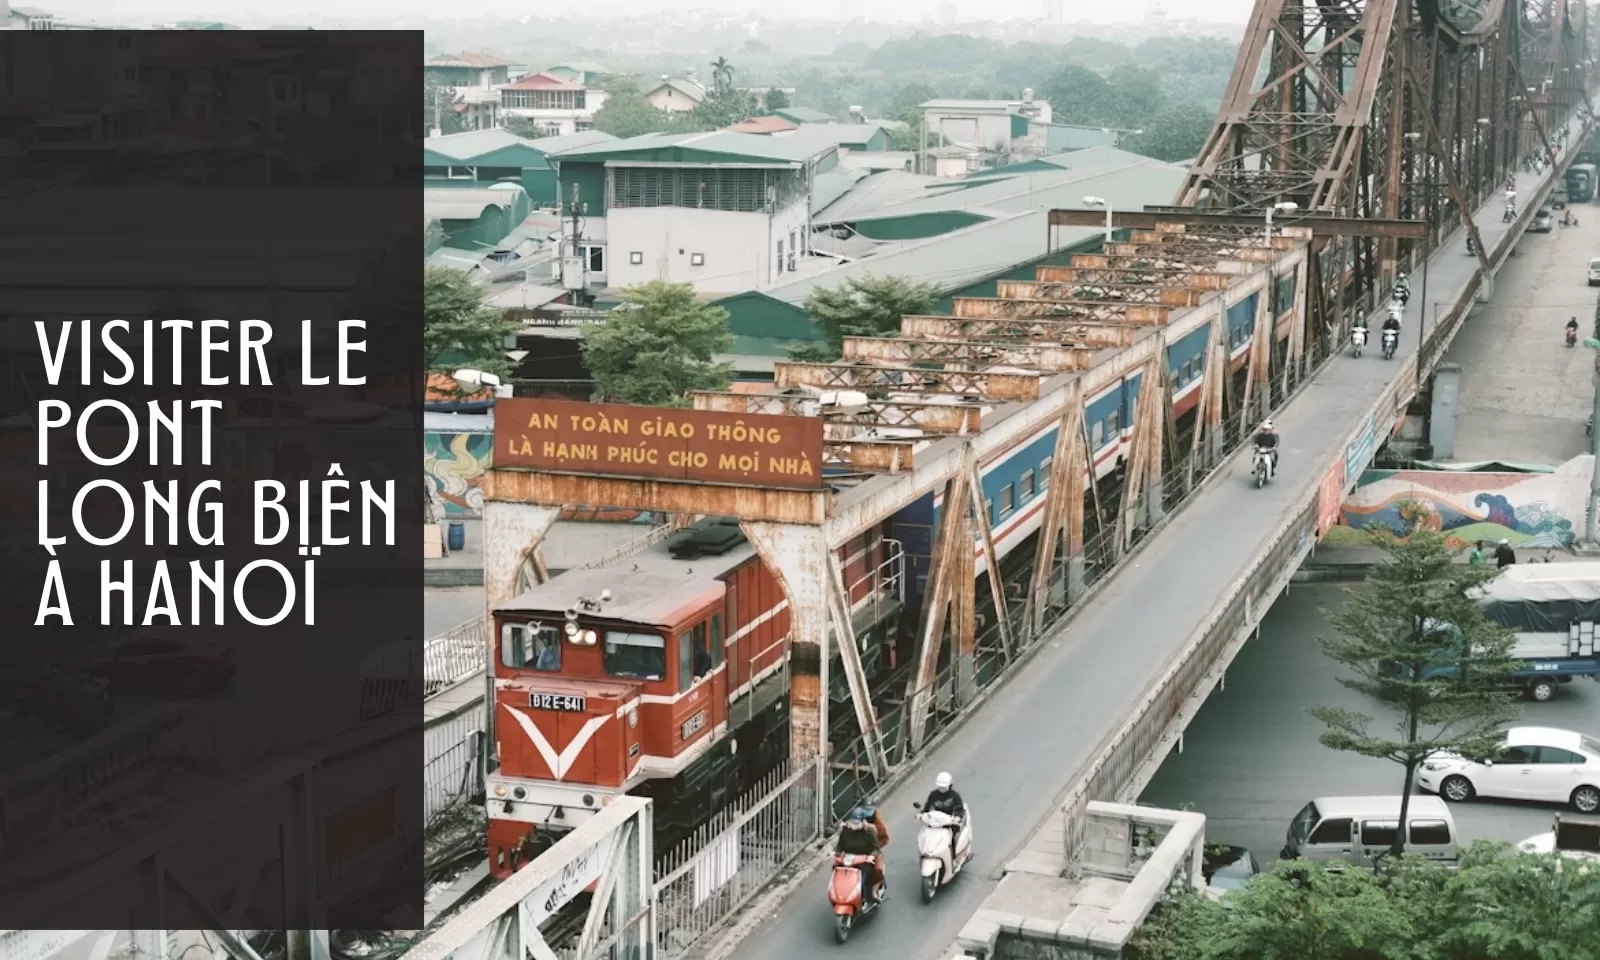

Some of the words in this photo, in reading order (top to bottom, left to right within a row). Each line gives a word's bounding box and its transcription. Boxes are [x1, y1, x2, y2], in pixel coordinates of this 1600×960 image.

[528, 412, 559, 430] AN
[570, 411, 629, 435] TOÀN
[706, 419, 782, 444] THÔNG
[508, 434, 533, 456] LÀ
[543, 441, 598, 461] HẠNH
[607, 441, 659, 465] PHÚC
[668, 450, 708, 469] CHO
[769, 452, 813, 476] NHÀ
